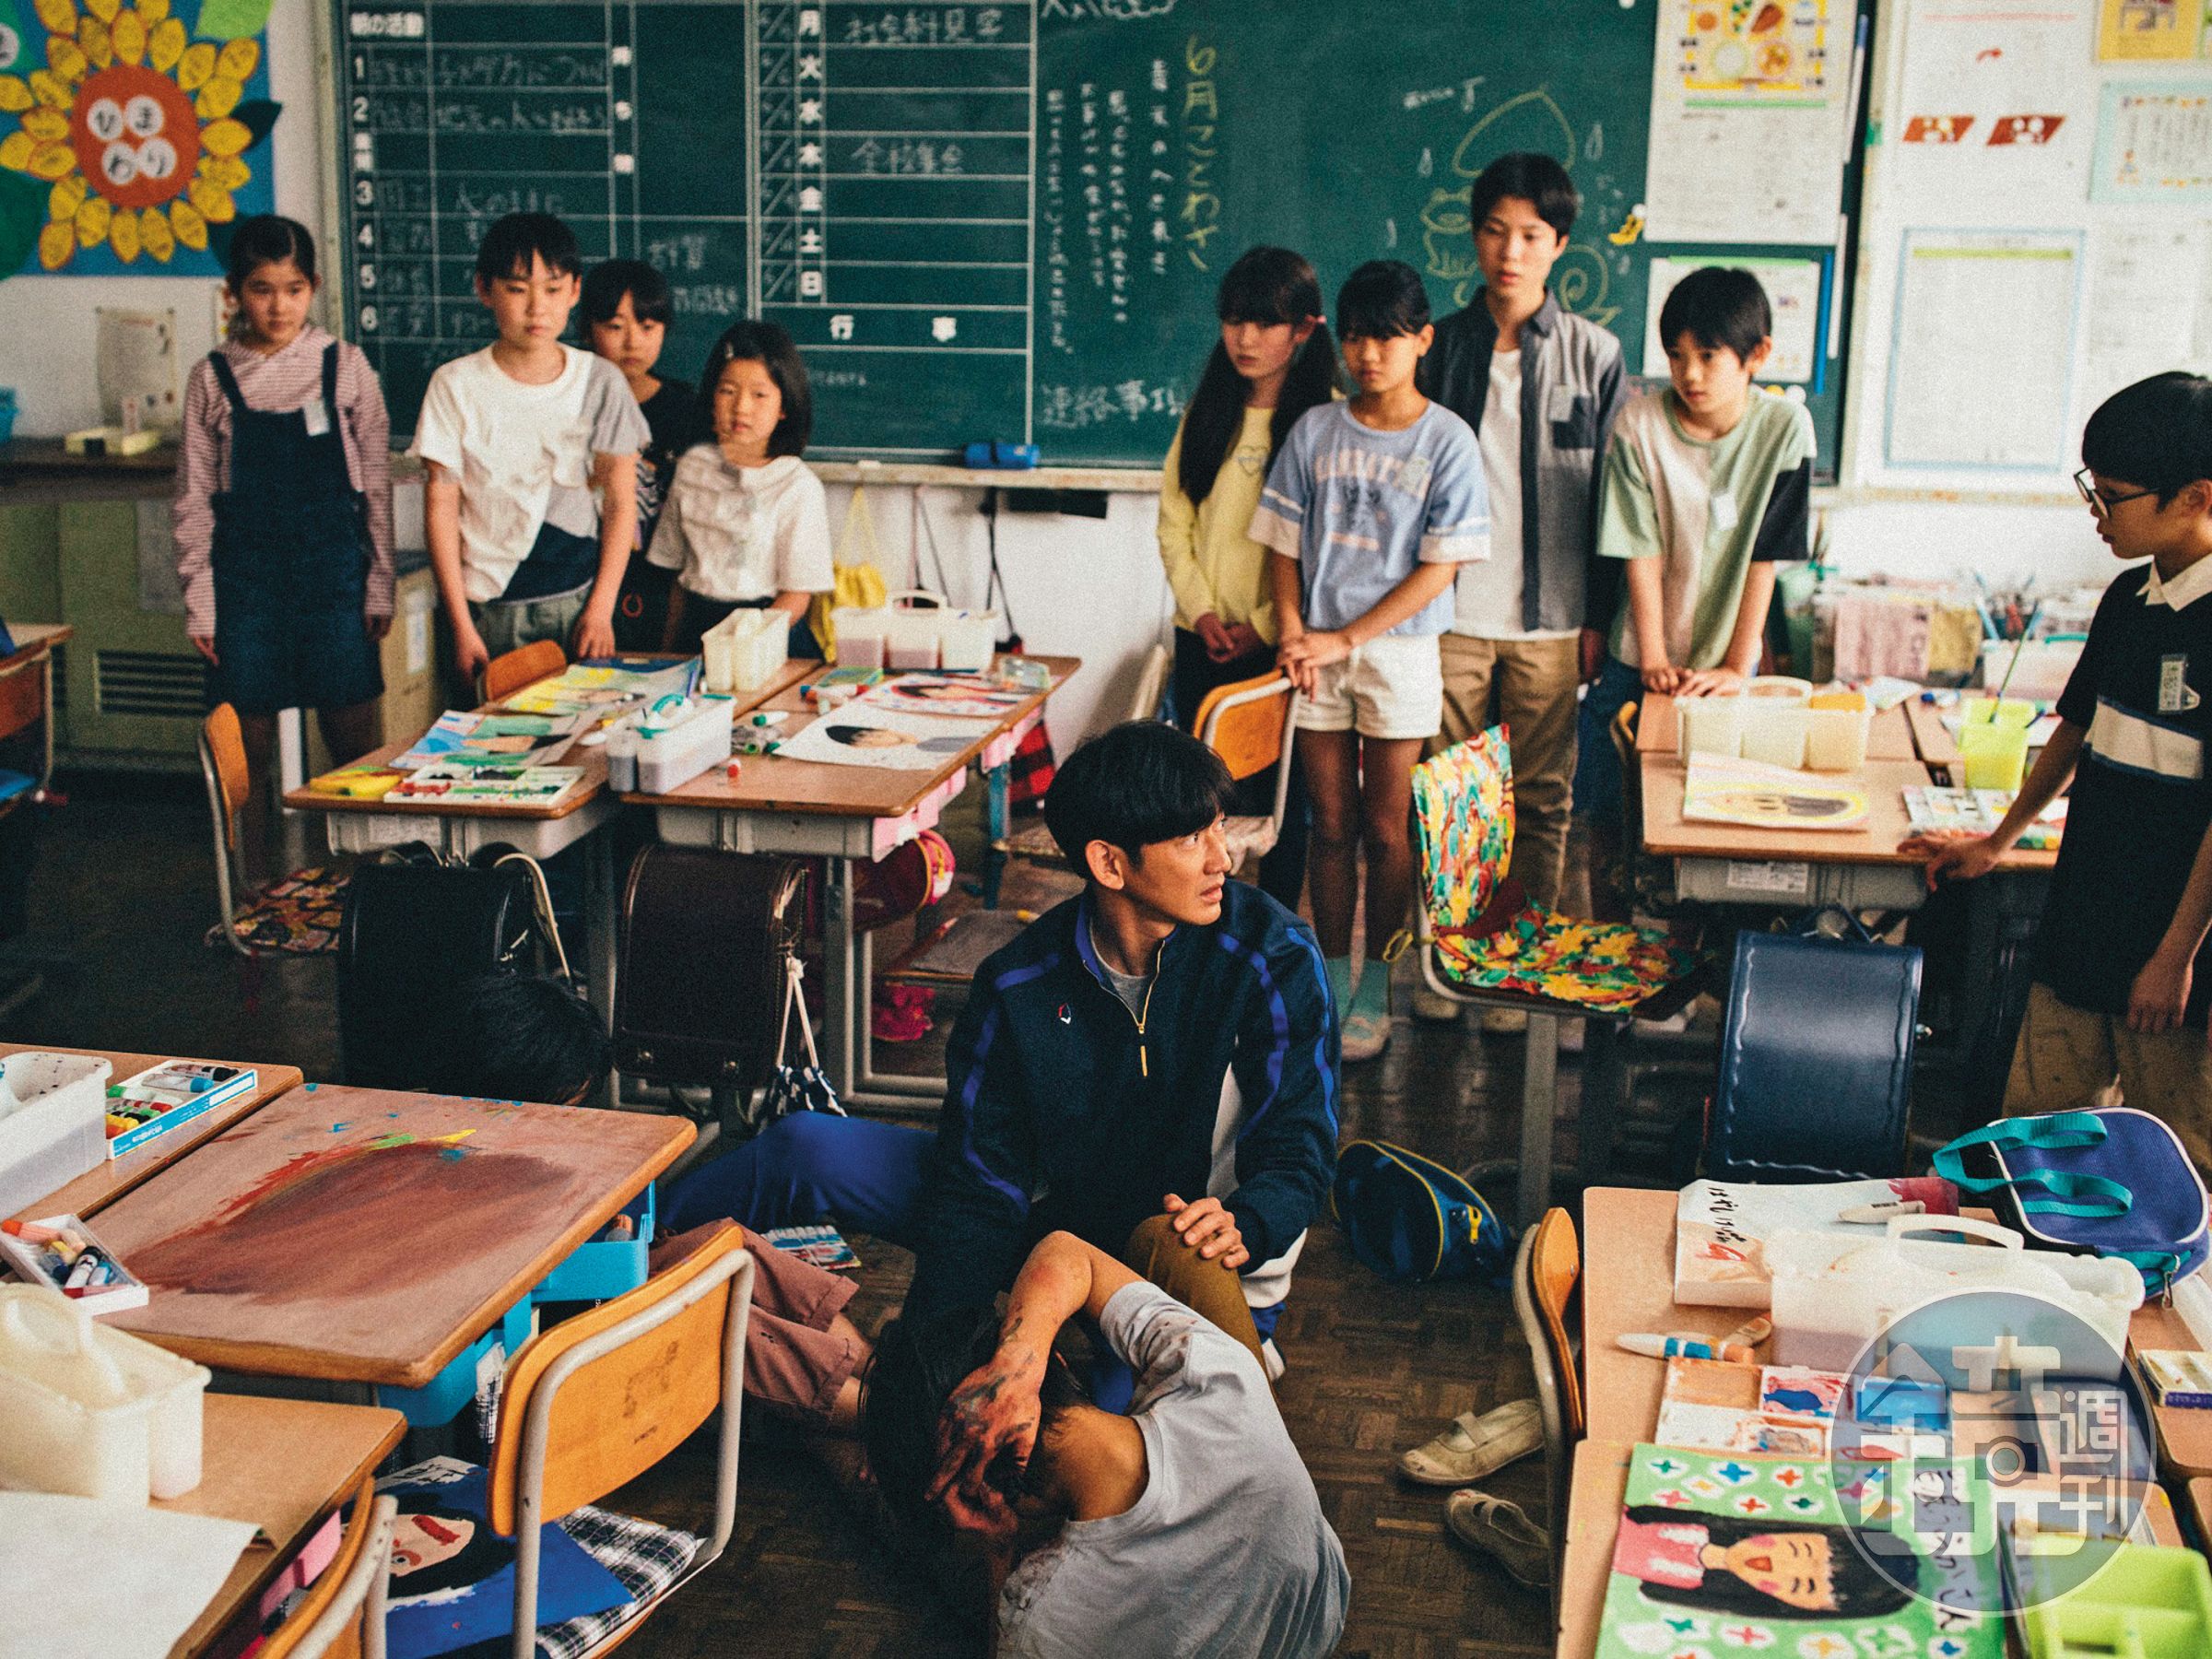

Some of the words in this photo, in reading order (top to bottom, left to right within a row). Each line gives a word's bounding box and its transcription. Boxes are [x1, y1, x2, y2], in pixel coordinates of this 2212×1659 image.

[354, 56, 365, 80] 1
[353, 96, 369, 123] 2
[356, 179, 374, 206] 3
[358, 223, 374, 248] 4
[799, 228, 823, 253] 土
[359, 264, 376, 289] 5
[801, 270, 822, 296] 日
[359, 305, 378, 332] 6
